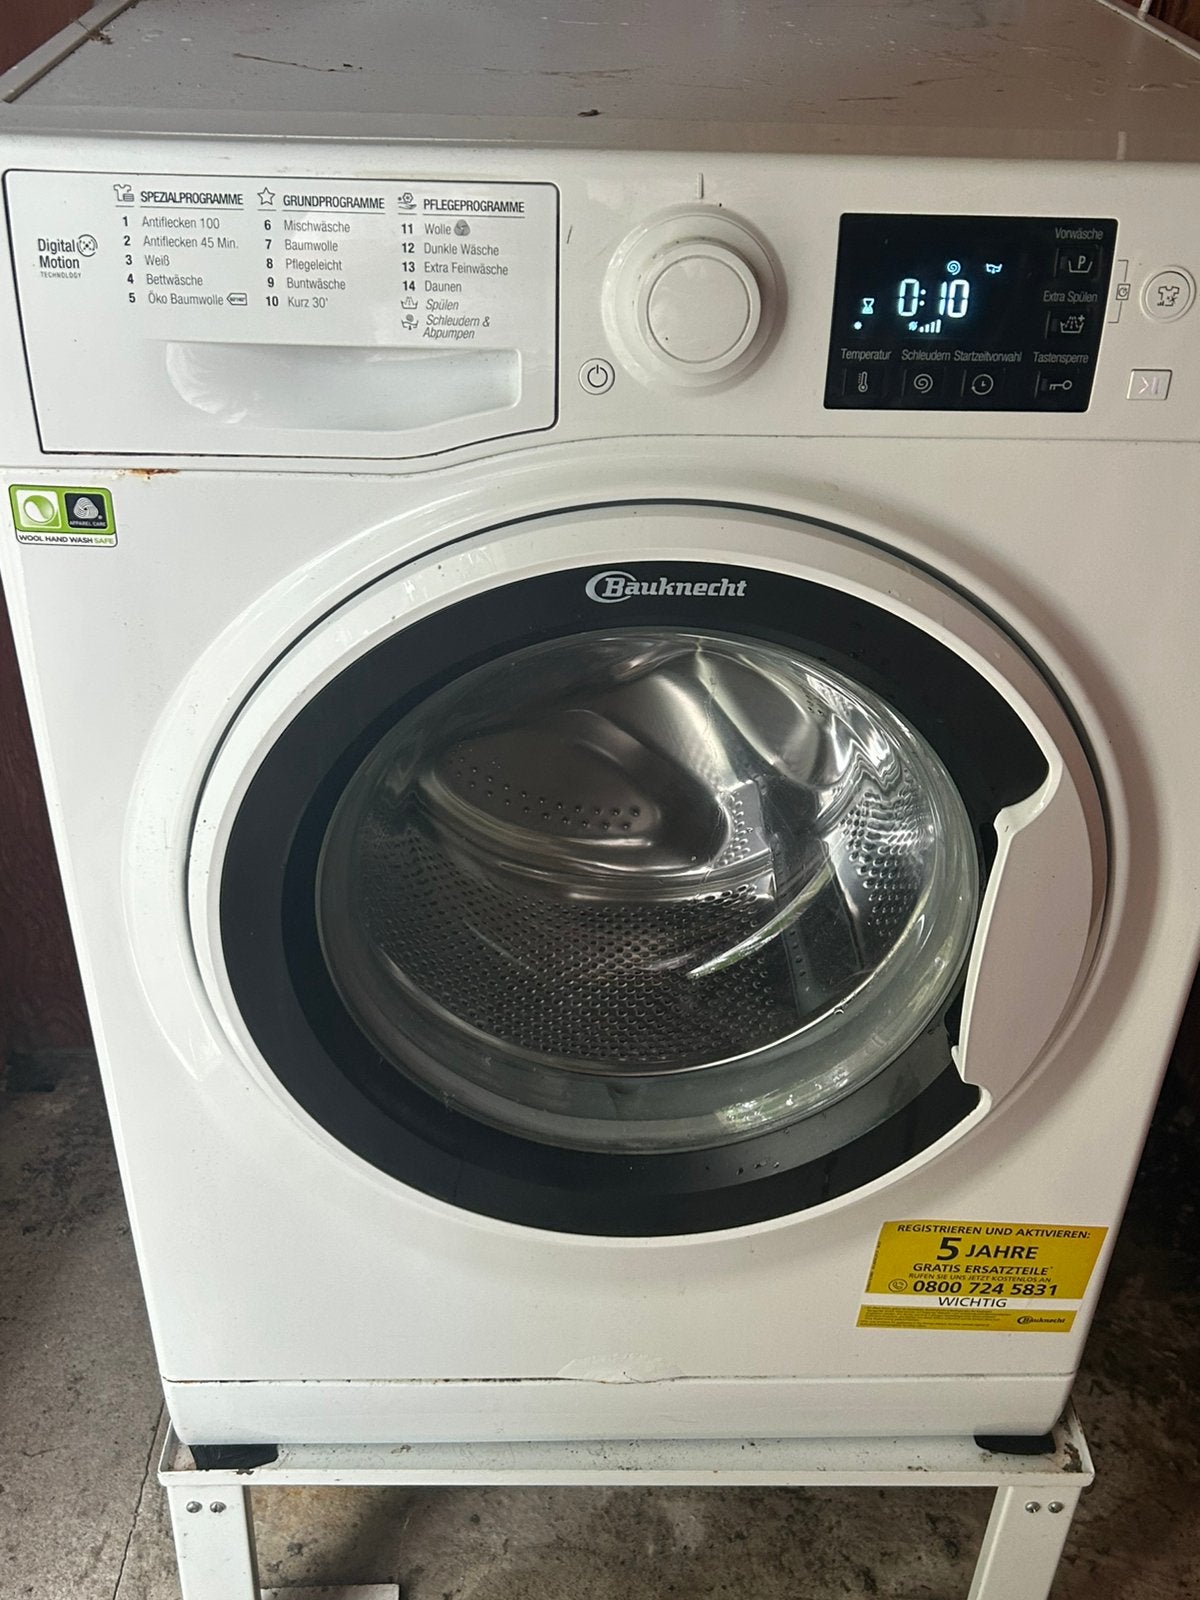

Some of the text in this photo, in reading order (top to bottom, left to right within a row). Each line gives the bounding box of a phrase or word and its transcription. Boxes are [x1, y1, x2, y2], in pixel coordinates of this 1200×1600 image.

[140, 191, 244, 205] SPEZIALPROGRAMME
[283, 195, 385, 209] GRUNDPROGRAMME
[423, 199, 525, 213] PFLEGEPROGRAMME
[123, 216, 220, 229] 1 Antiflecken 100
[264, 219, 350, 233] 6 Mischwäsche
[401, 223, 452, 235] 11 Wolle
[1055, 228, 1103, 240] Vorwäsche
[37, 239, 75, 255] Digital
[124, 236, 239, 249] 2 Antiflecken 45 Min.
[265, 239, 338, 252] 7 Baumwolle
[402, 243, 499, 256] 12 Dunkle Wäsche
[39, 256, 80, 269] Motion
[125, 255, 170, 266] 3 Weiß
[266, 258, 342, 272] 8 Pflegeleicht
[402, 262, 508, 275] 13 Extra Feinwäsche
[127, 273, 203, 286] 4 Bettwäsche
[268, 277, 346, 290] 9 Buntwäsche
[402, 281, 462, 292] 14 Daunen
[129, 293, 136, 303] 5
[148, 292, 168, 304] Öko
[171, 294, 224, 305] Baumwolle
[266, 296, 279, 307] 10
[287, 296, 310, 307] Kurz
[897, 278, 970, 318] 0:10
[1043, 291, 1098, 304] Extra Spülen
[425, 299, 459, 312] Spülen
[426, 315, 490, 327] Schleudern &
[423, 328, 475, 340] Abpumpen
[841, 348, 892, 361] Temperatur
[901, 349, 950, 361] Schleudern
[954, 350, 1022, 362] Startzeitvorwahl
[1033, 352, 1089, 364] Tastensperre
[601, 576, 747, 597] Bauknecht
[897, 1224, 1090, 1238] REGISTRIEREN UND AKTIVIEREN:
[936, 1237, 1038, 1260] 5 JAHRE
[913, 1263, 961, 1273] GRATIS
[913, 1280, 1057, 1296] 0800 724 5831
[938, 1296, 1007, 1308] WICHTIG
